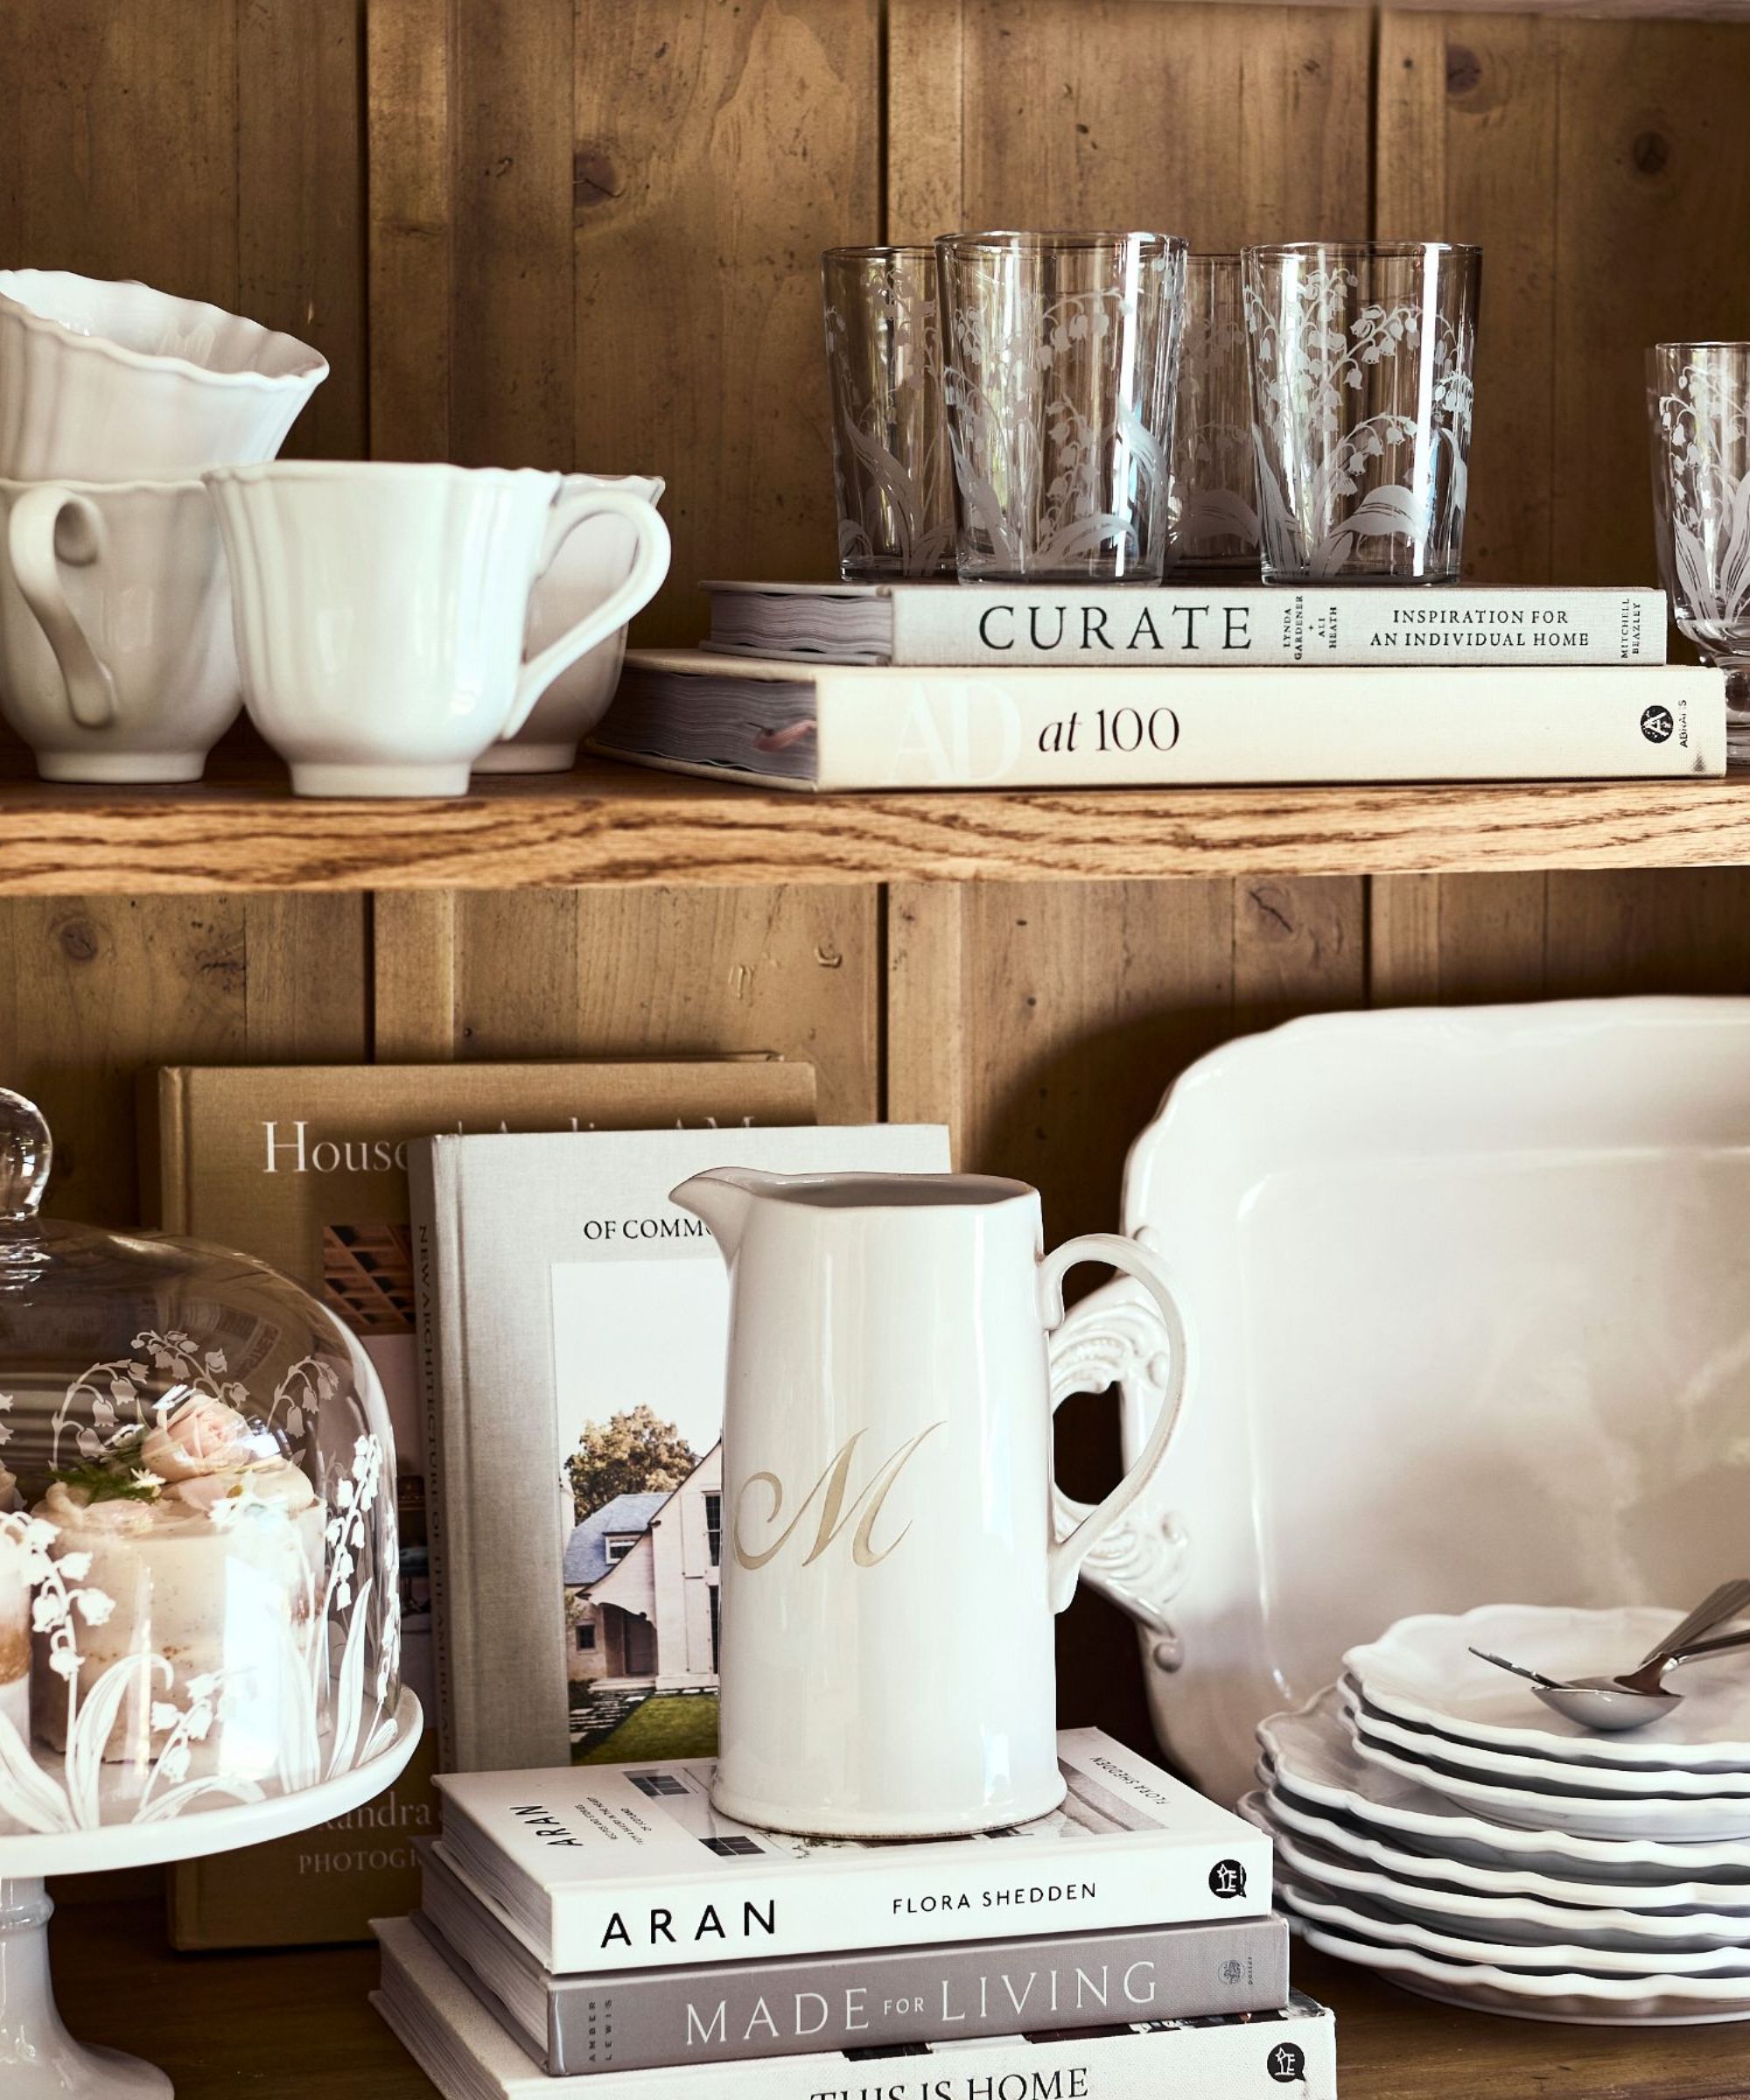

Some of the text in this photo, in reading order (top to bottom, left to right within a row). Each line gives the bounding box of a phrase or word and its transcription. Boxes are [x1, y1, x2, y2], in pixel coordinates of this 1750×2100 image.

[978, 605, 1252, 651] CURATE
[1283, 608, 1292, 648] LYNDA
[1294, 595, 1303, 661] GARDENER
[1328, 606, 1337, 649] HEATH
[1369, 633, 1589, 647] AN INDIVIDUAL HOME
[1393, 609, 1568, 624] INSPIRATION FOR
[1620, 598, 1630, 659] MITCHELL
[1631, 602, 1641, 654] BEAZLEY
[878, 681, 1180, 783] AD at 100
[1678, 699, 1688, 749] ABRAS
[583, 1219, 711, 1240] OF COMM
[419, 1225, 430, 1287] NEW
[733, 1420, 948, 1571] M
[1090, 1756, 1139, 1784] SHEDDEN
[509, 1804, 584, 1846] ARAN
[600, 1882, 1096, 1949] ARAN FLORA SHEDDEN
[686, 1960, 1156, 2046] MADE FOR LIVING
[604, 1999, 612, 2062] LEWIS
[967, 2067, 1088, 2100] HOME
